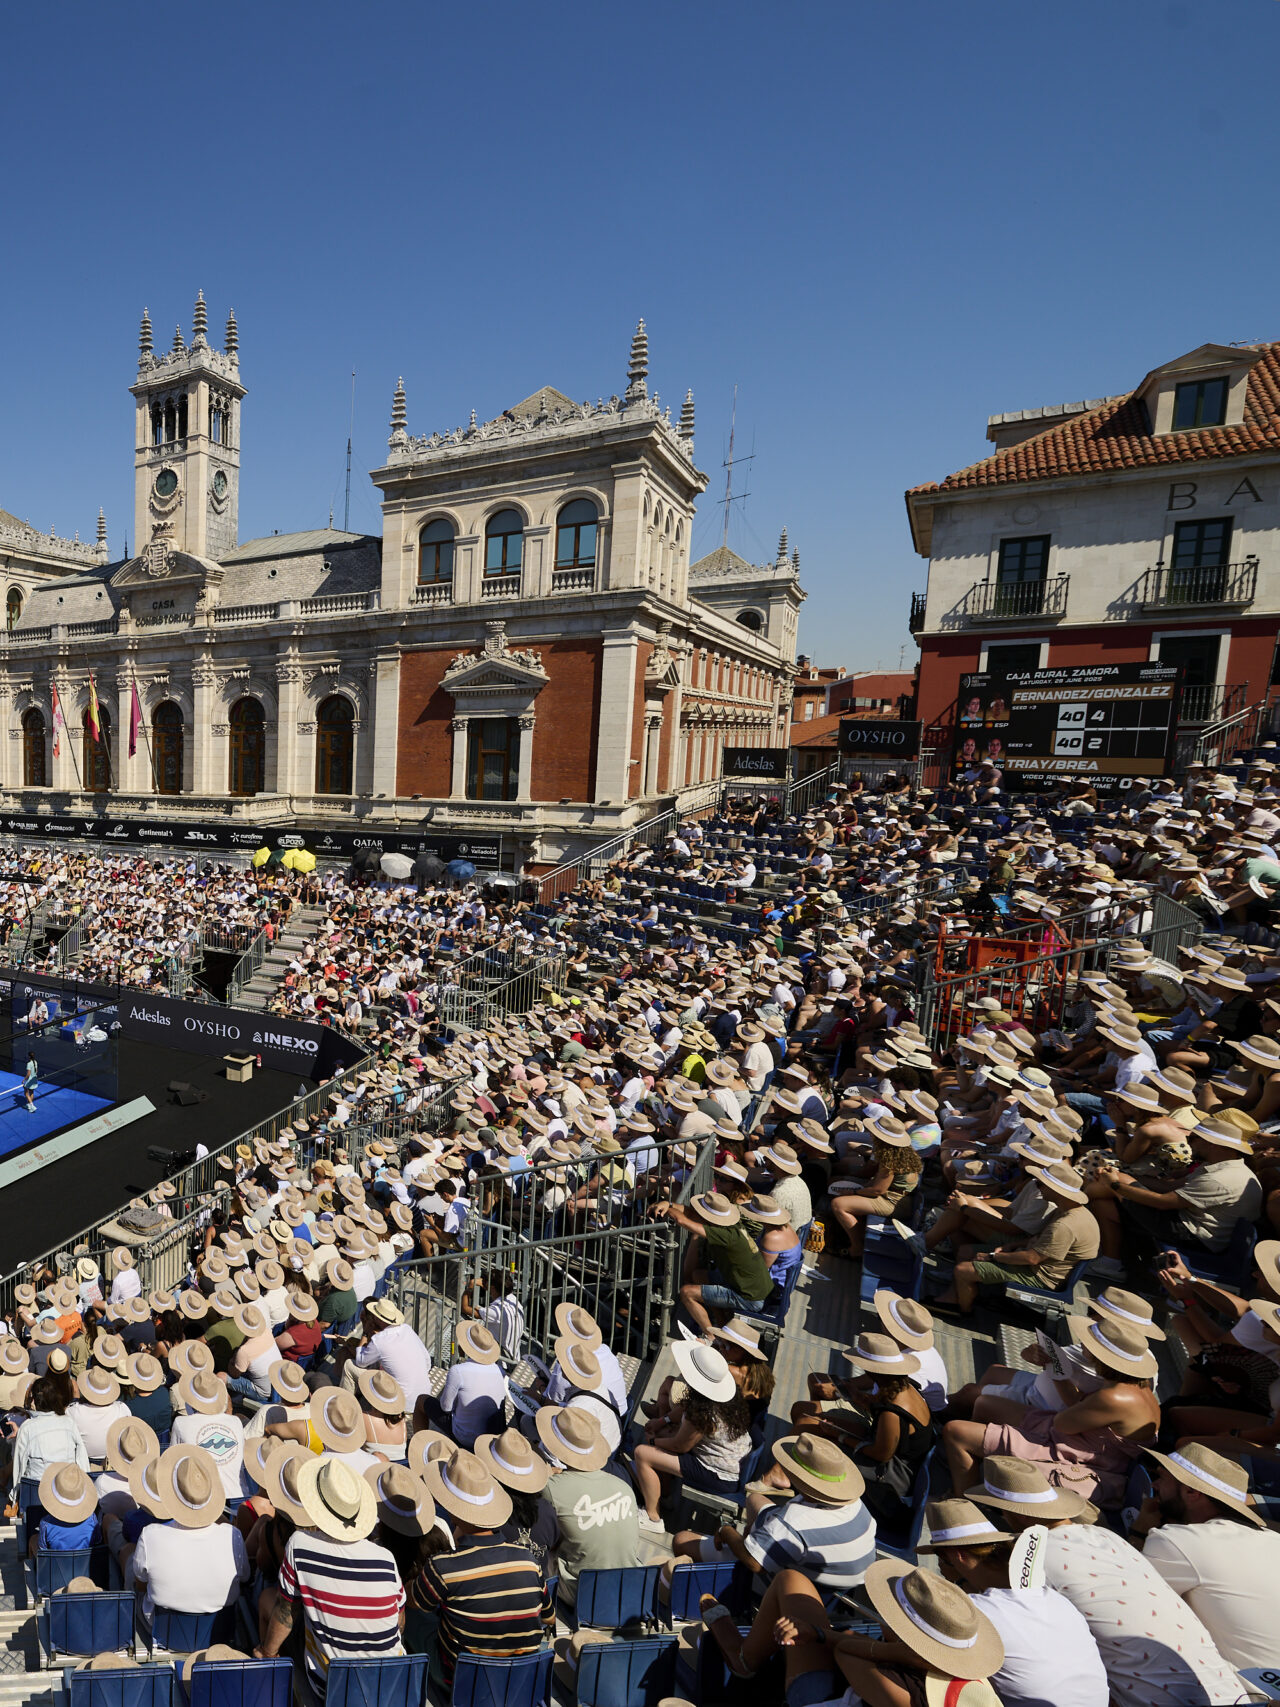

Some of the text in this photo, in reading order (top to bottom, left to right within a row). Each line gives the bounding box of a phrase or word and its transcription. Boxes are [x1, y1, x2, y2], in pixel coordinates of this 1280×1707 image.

[152, 600, 175, 610] CASA
[135, 612, 193, 628] CONSISTORIAL
[1006, 667, 1120, 681] CAJA RURAL ZAMORA
[1013, 686, 1171, 702] FERNANDEZ/GONZALEZ
[1060, 710, 1106, 722] 40 4
[848, 729, 906, 745] OYSHO
[1056, 738, 1102, 750] 40 2
[733, 755, 775, 771] Adeslas
[1007, 760, 1099, 770] TRIAY/BREA
[353, 838, 383, 847] QATAR
[130, 1006, 171, 1026] Adeslas
[184, 1017, 241, 1040] OYSHO
[264, 1031, 319, 1052] INEXO
[264, 1044, 318, 1058] CONSTRUCTORA
